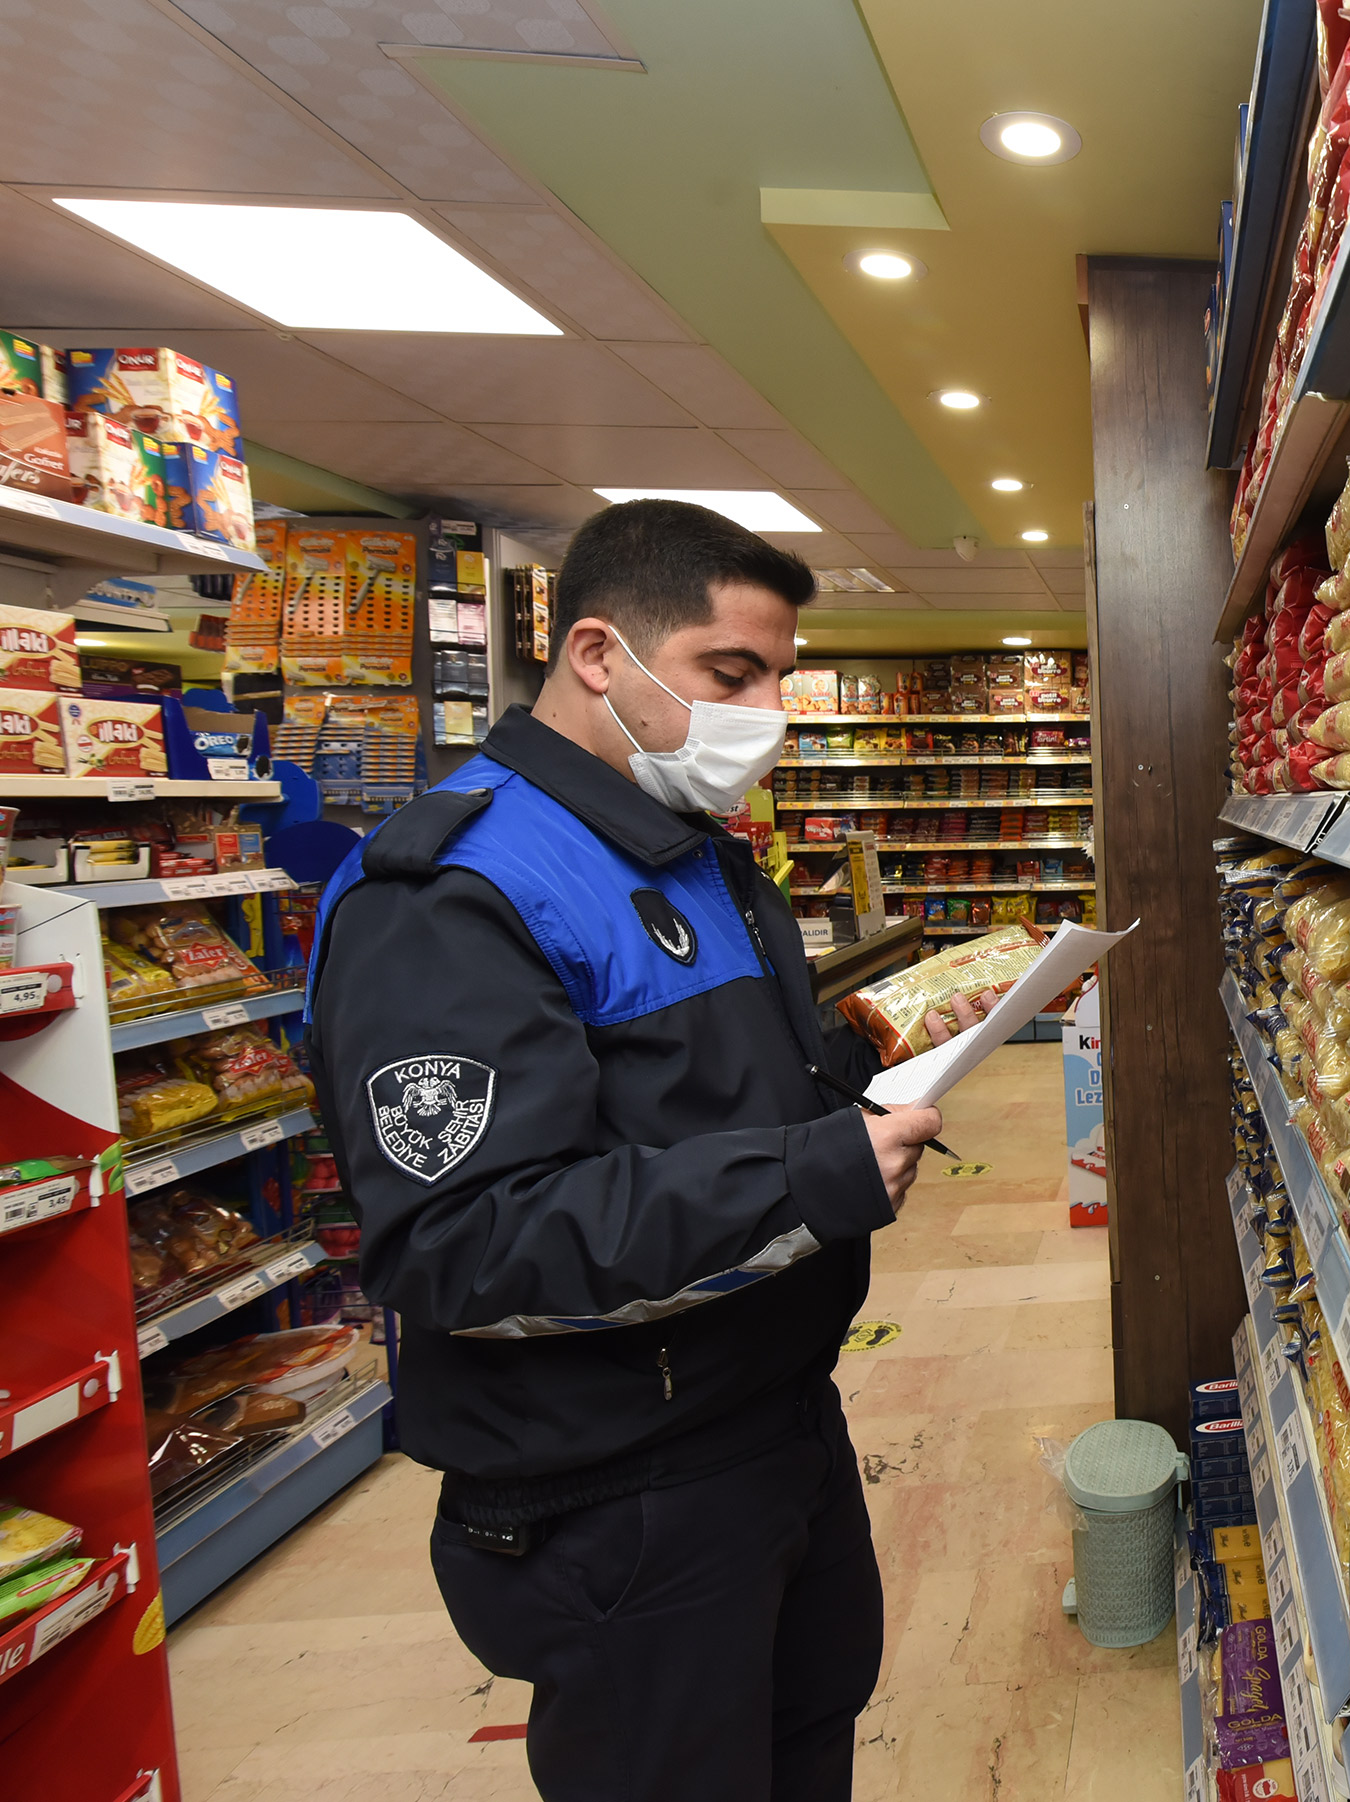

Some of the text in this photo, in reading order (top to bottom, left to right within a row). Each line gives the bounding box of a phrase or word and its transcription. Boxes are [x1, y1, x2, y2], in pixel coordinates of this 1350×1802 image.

[118, 354, 155, 366] ONUR
[194, 735, 234, 750] OREO
[189, 948, 223, 960] Zafer
[14, 991, 35, 1003] 4,95
[395, 1061, 460, 1083] KONYA
[390, 1105, 433, 1150] BÜYÜK
[437, 1099, 469, 1143] ŞEHİR
[378, 1105, 428, 1168] BELEDİYE
[1209, 1379, 1238, 1390] Barill
[1255, 1625, 1269, 1662] GOLDA
[1228, 1713, 1283, 1729] GOLDA
